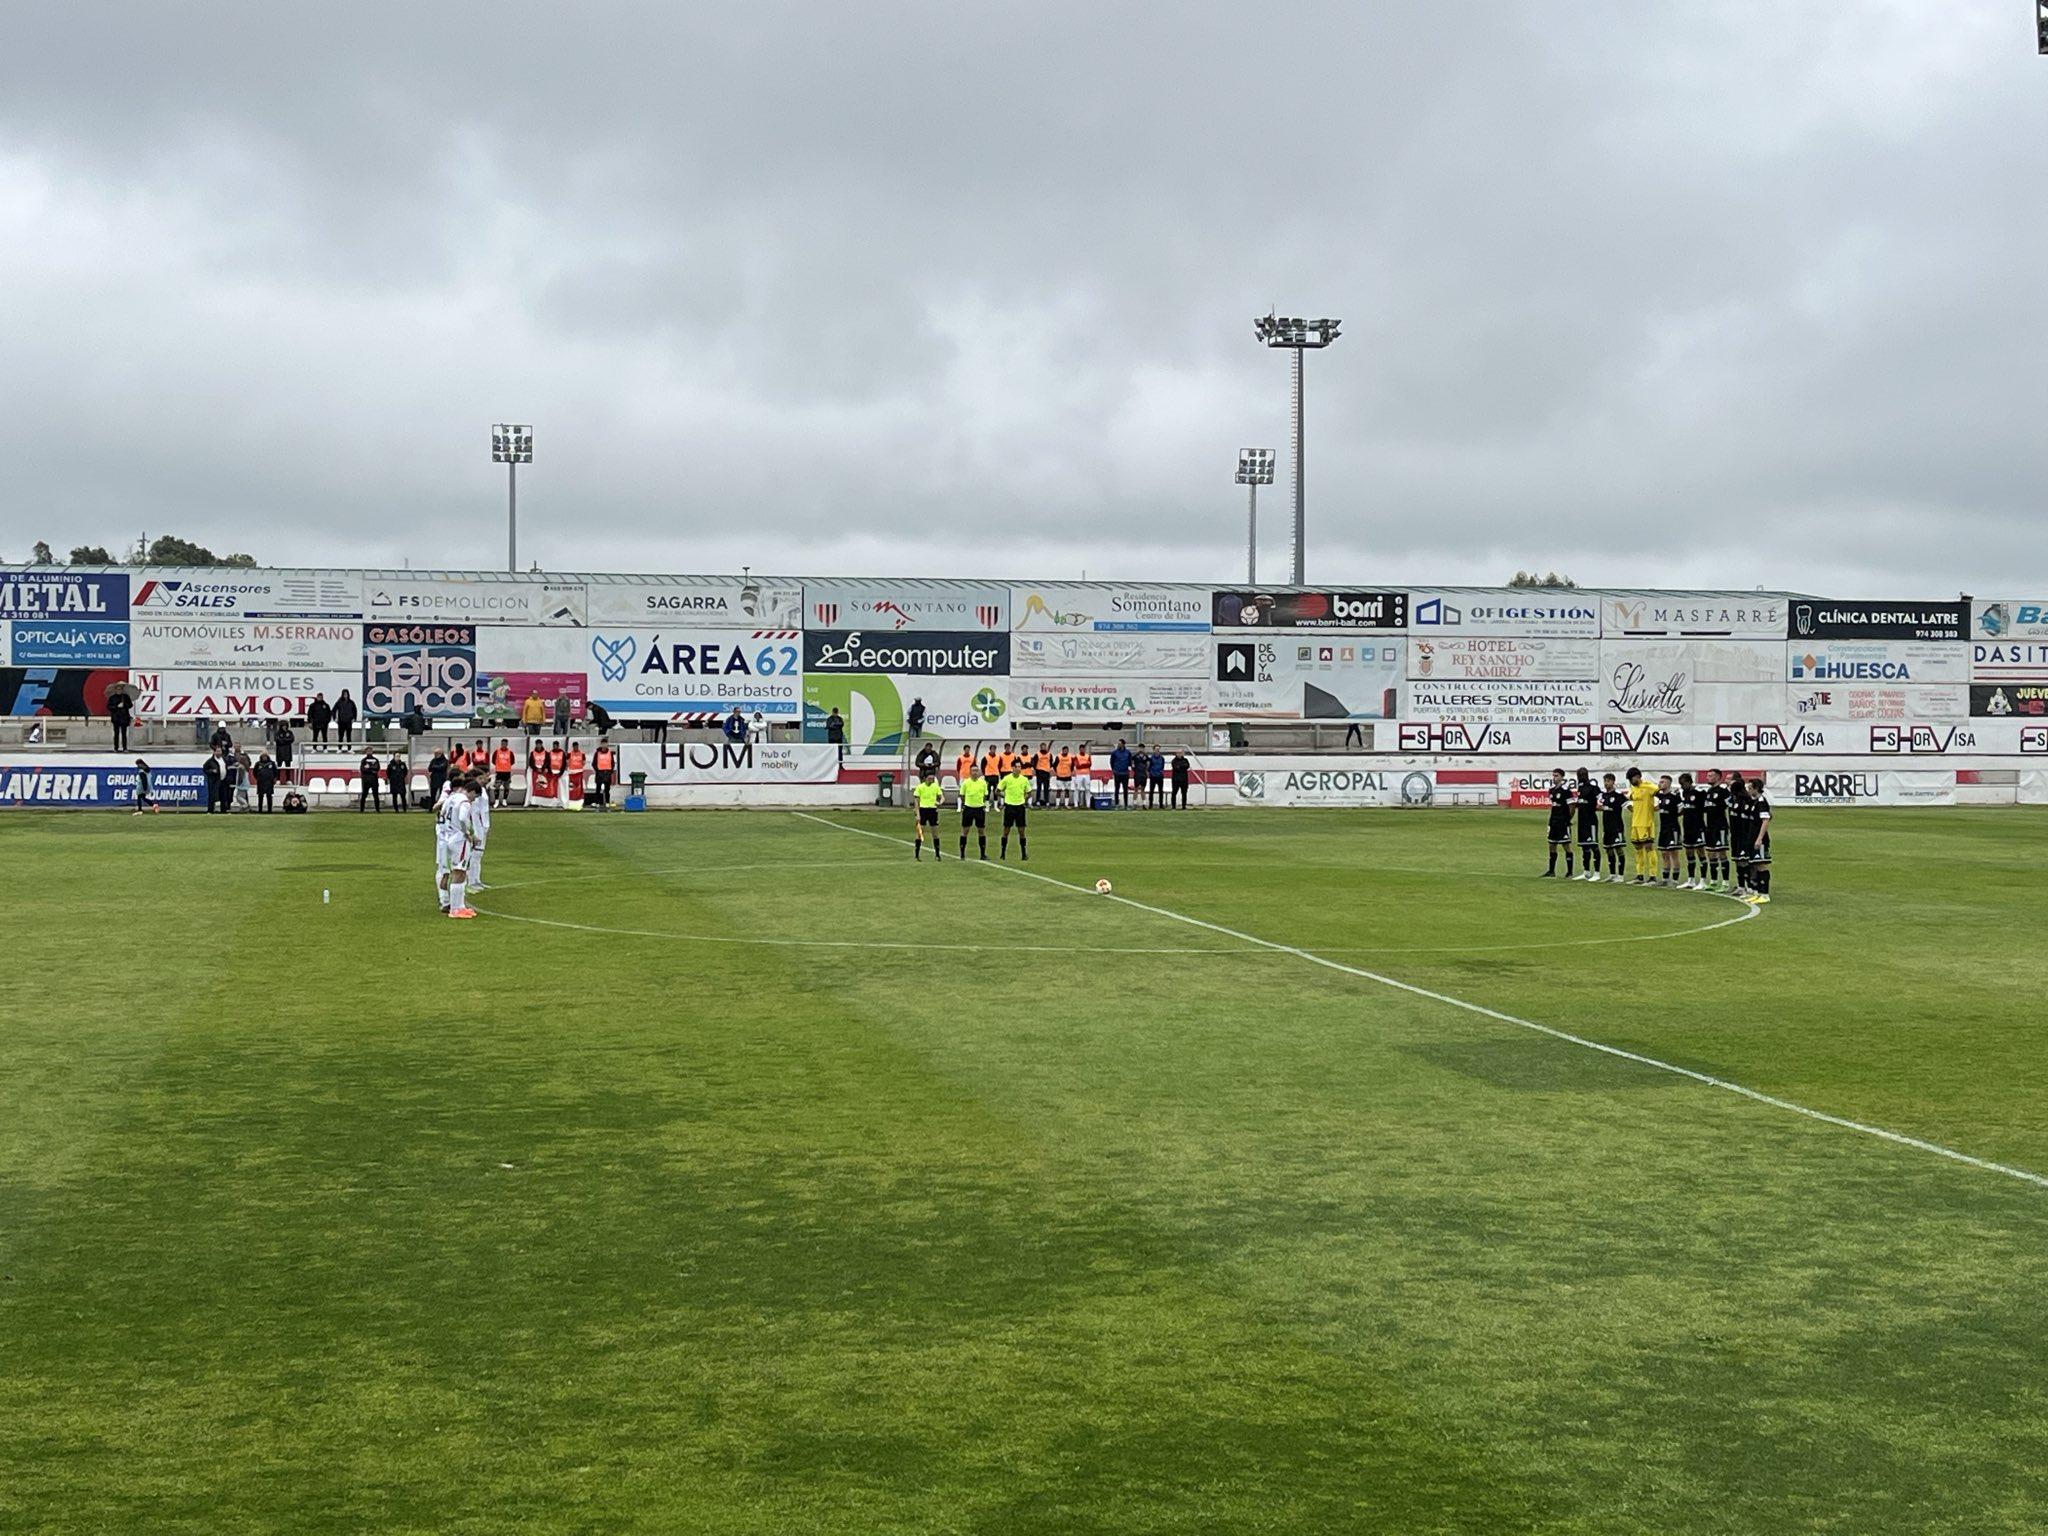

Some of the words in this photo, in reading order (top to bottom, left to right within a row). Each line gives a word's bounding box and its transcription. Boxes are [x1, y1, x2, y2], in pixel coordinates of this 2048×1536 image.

[28, 575, 82, 583] ALUMINIO
[182, 583, 271, 594] Ascensores
[175, 595, 237, 607] SALES
[647, 596, 728, 609] SAGARRA
[1112, 597, 1201, 612] Somontano
[1333, 595, 1383, 618] barri
[1471, 606, 1595, 619] OFIGESTIÓN
[1654, 607, 1777, 623] MASFARRÉ
[1818, 609, 1868, 623] CLÍNICA
[1871, 612, 1918, 624] DENTAL
[1922, 613, 1959, 624] LATRE
[142, 624, 245, 639] AUTOMÓVILES
[254, 626, 354, 640] M.SERRANO
[369, 627, 470, 644] GASÓLEOS
[89, 633, 126, 645] VERO
[1259, 644, 1273, 653] DE
[1468, 640, 1516, 652] HOTEL
[860, 645, 998, 673] ecomputer
[1258, 653, 1276, 663] CO
[1452, 654, 1474, 665] REY
[1480, 654, 1535, 666] SANCHO
[367, 647, 473, 687] Petro
[1259, 663, 1267, 672] Y
[1828, 663, 1910, 679] HUESCA
[197, 675, 314, 690] MÁRMOLES
[1258, 672, 1273, 682] BA
[138, 676, 159, 692] M
[635, 683, 663, 696] Con
[668, 684, 679, 696] la
[684, 685, 713, 696] U.D.
[717, 684, 793, 697] Barbastro
[1041, 684, 1067, 693] frutas
[1078, 685, 1117, 693] verduras
[1414, 683, 1521, 691] CONSTRUCCIONES
[141, 695, 156, 712] Z
[1021, 696, 1136, 711] GARRIGA
[1413, 695, 1492, 705] TALLERES
[1497, 696, 1583, 706] SOMONTAL
[776, 705, 795, 713] A22
[661, 744, 752, 769] HOM
[761, 750, 778, 758] hub
[781, 750, 791, 758] of
[761, 762, 798, 770] mobility
[155, 775, 204, 785] ALQUILER
[1285, 772, 1388, 790] AGROPAL
[1796, 774, 1878, 796] BARREU
[114, 790, 127, 800] DE
